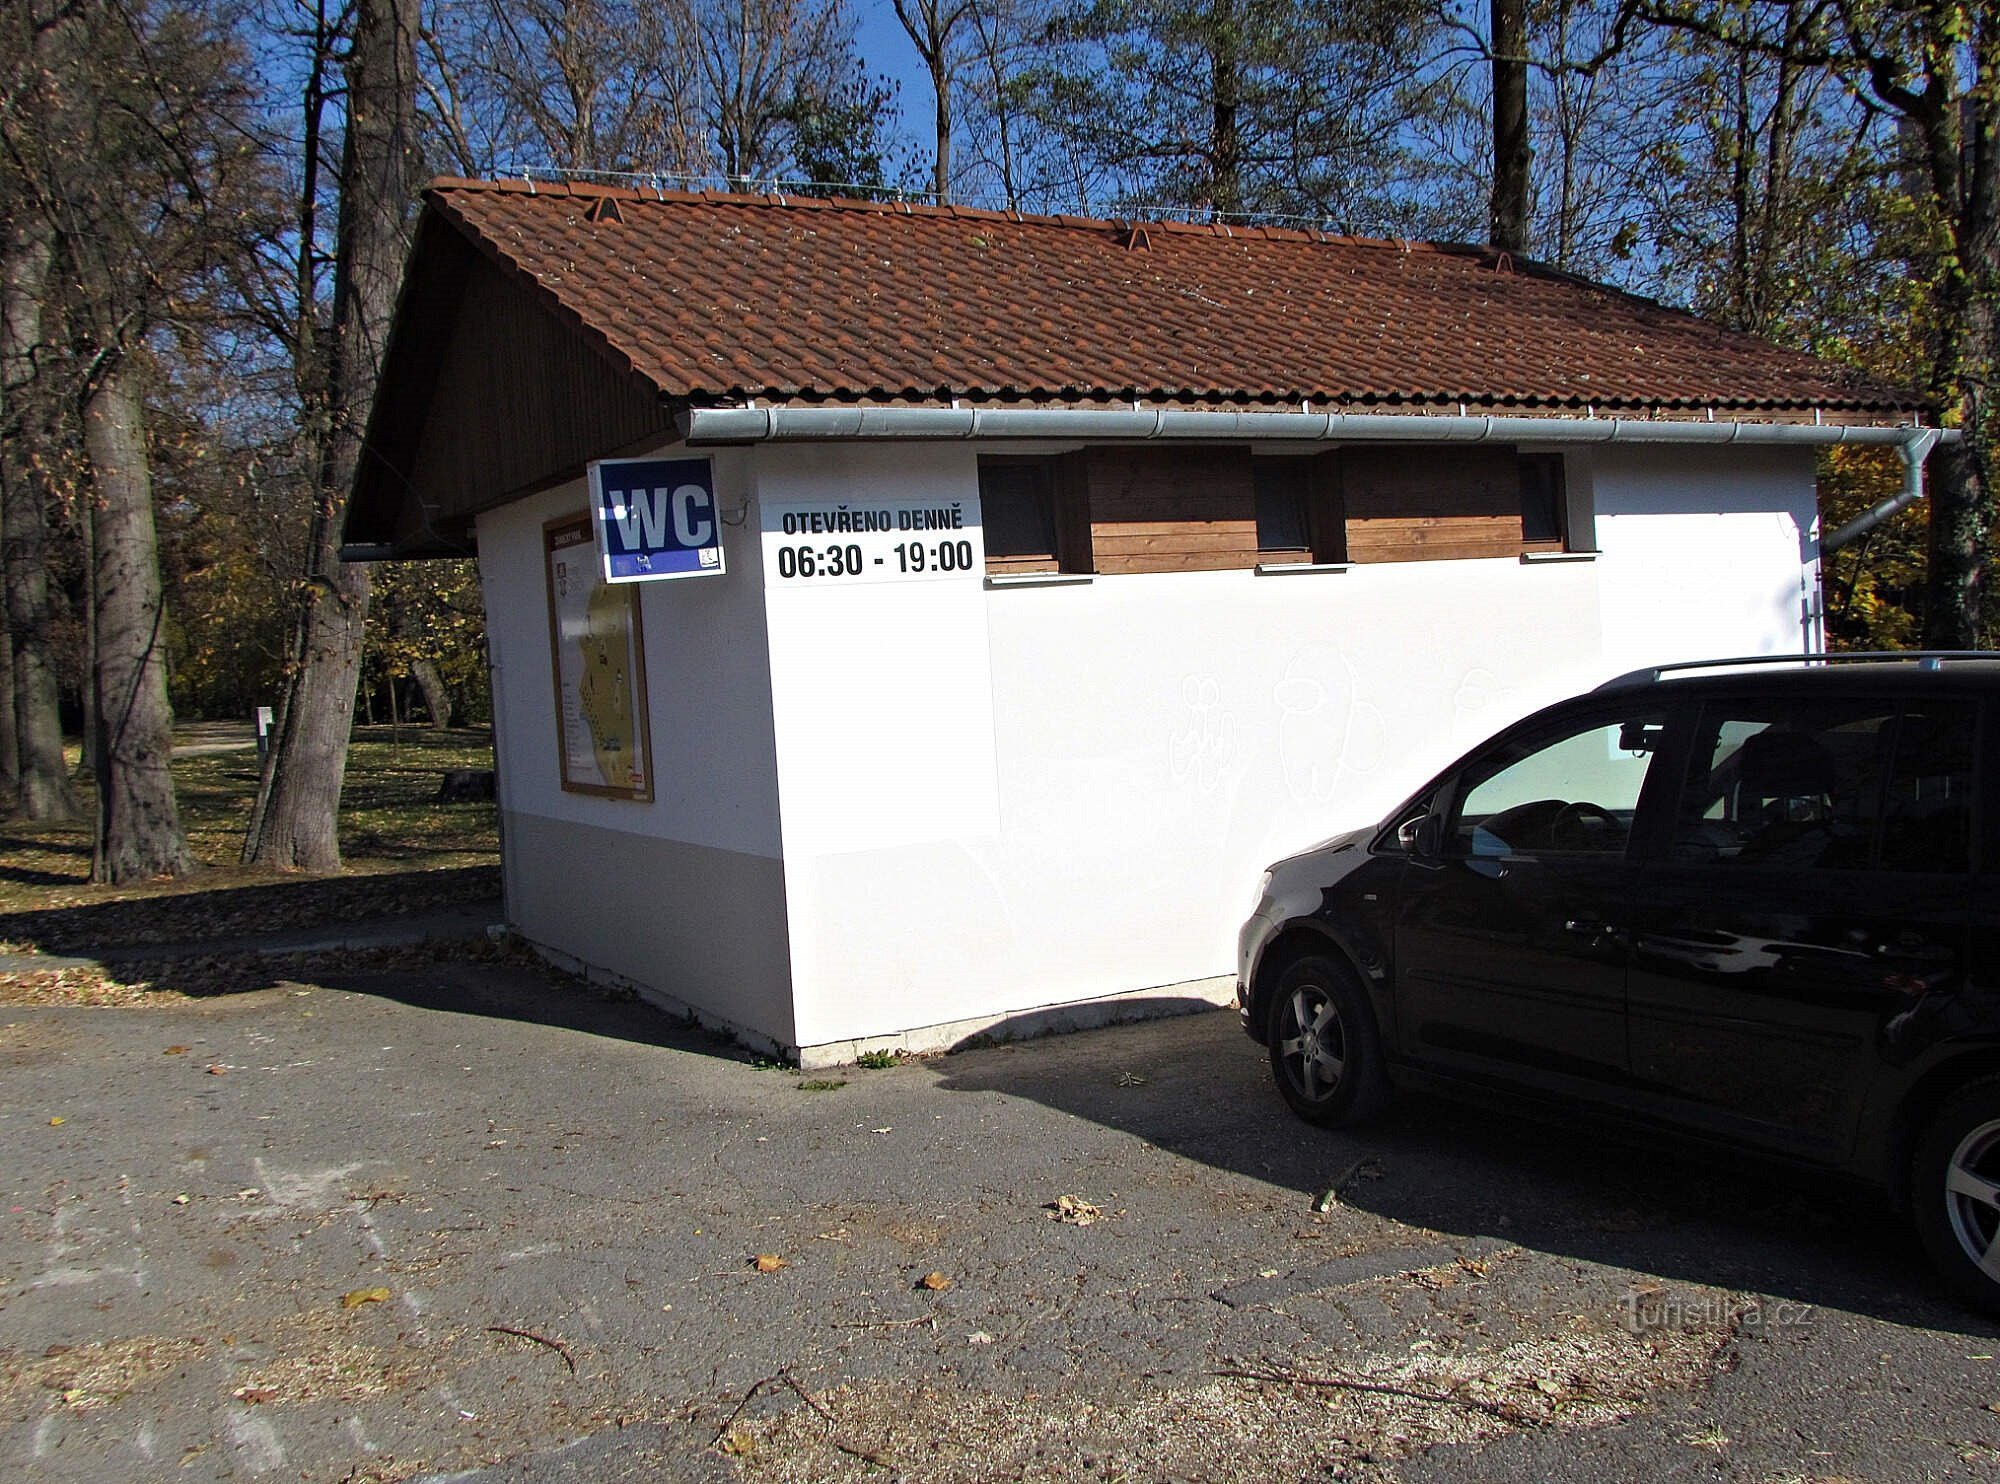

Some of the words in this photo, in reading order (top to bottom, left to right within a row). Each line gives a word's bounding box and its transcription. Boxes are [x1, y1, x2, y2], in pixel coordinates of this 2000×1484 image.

[609, 484, 712, 550] WC
[782, 505, 891, 535] OTEVŘENO
[898, 502, 963, 531] DENNĚ
[778, 544, 863, 578] 06:30
[893, 540, 973, 573] 19:00
